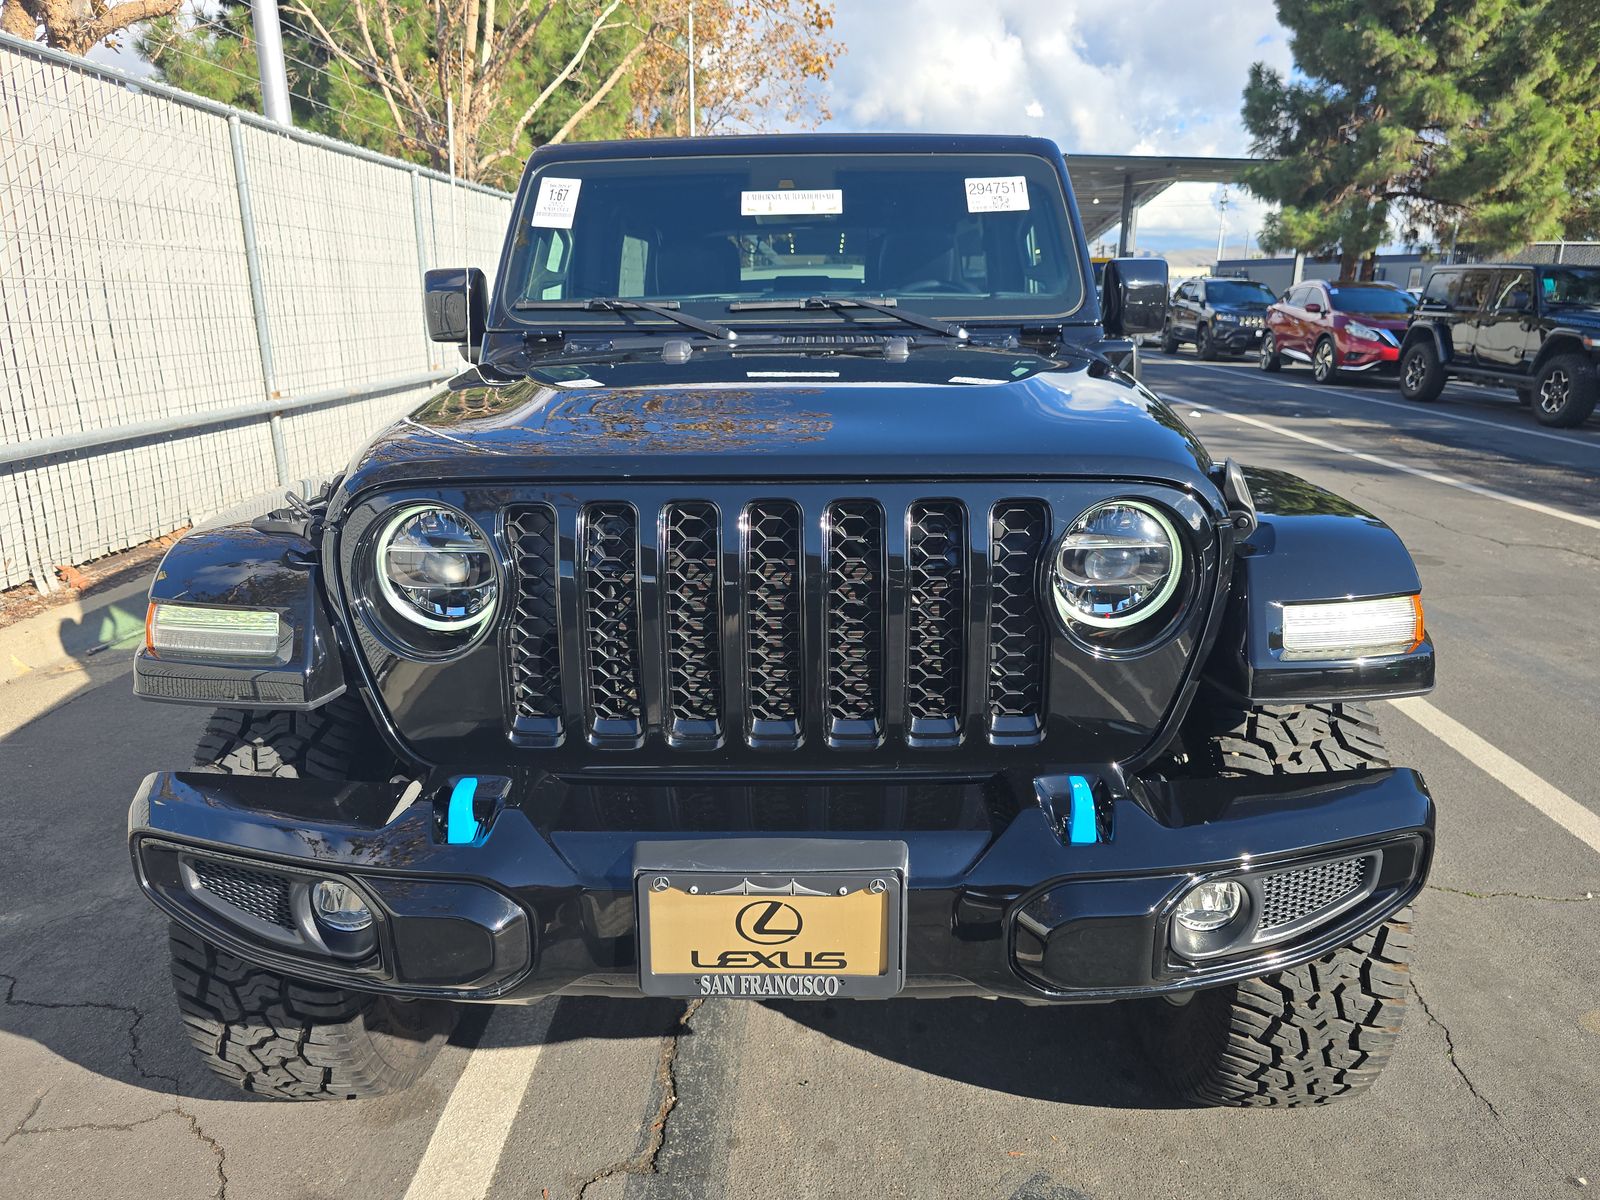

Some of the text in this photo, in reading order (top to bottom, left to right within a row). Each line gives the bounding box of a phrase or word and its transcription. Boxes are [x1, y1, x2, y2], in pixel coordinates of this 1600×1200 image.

[549, 188, 569, 202] 1:67
[968, 182, 1024, 195] 2947511
[690, 950, 848, 969] LEXUS
[700, 974, 839, 996] SAN FRANCISCO
